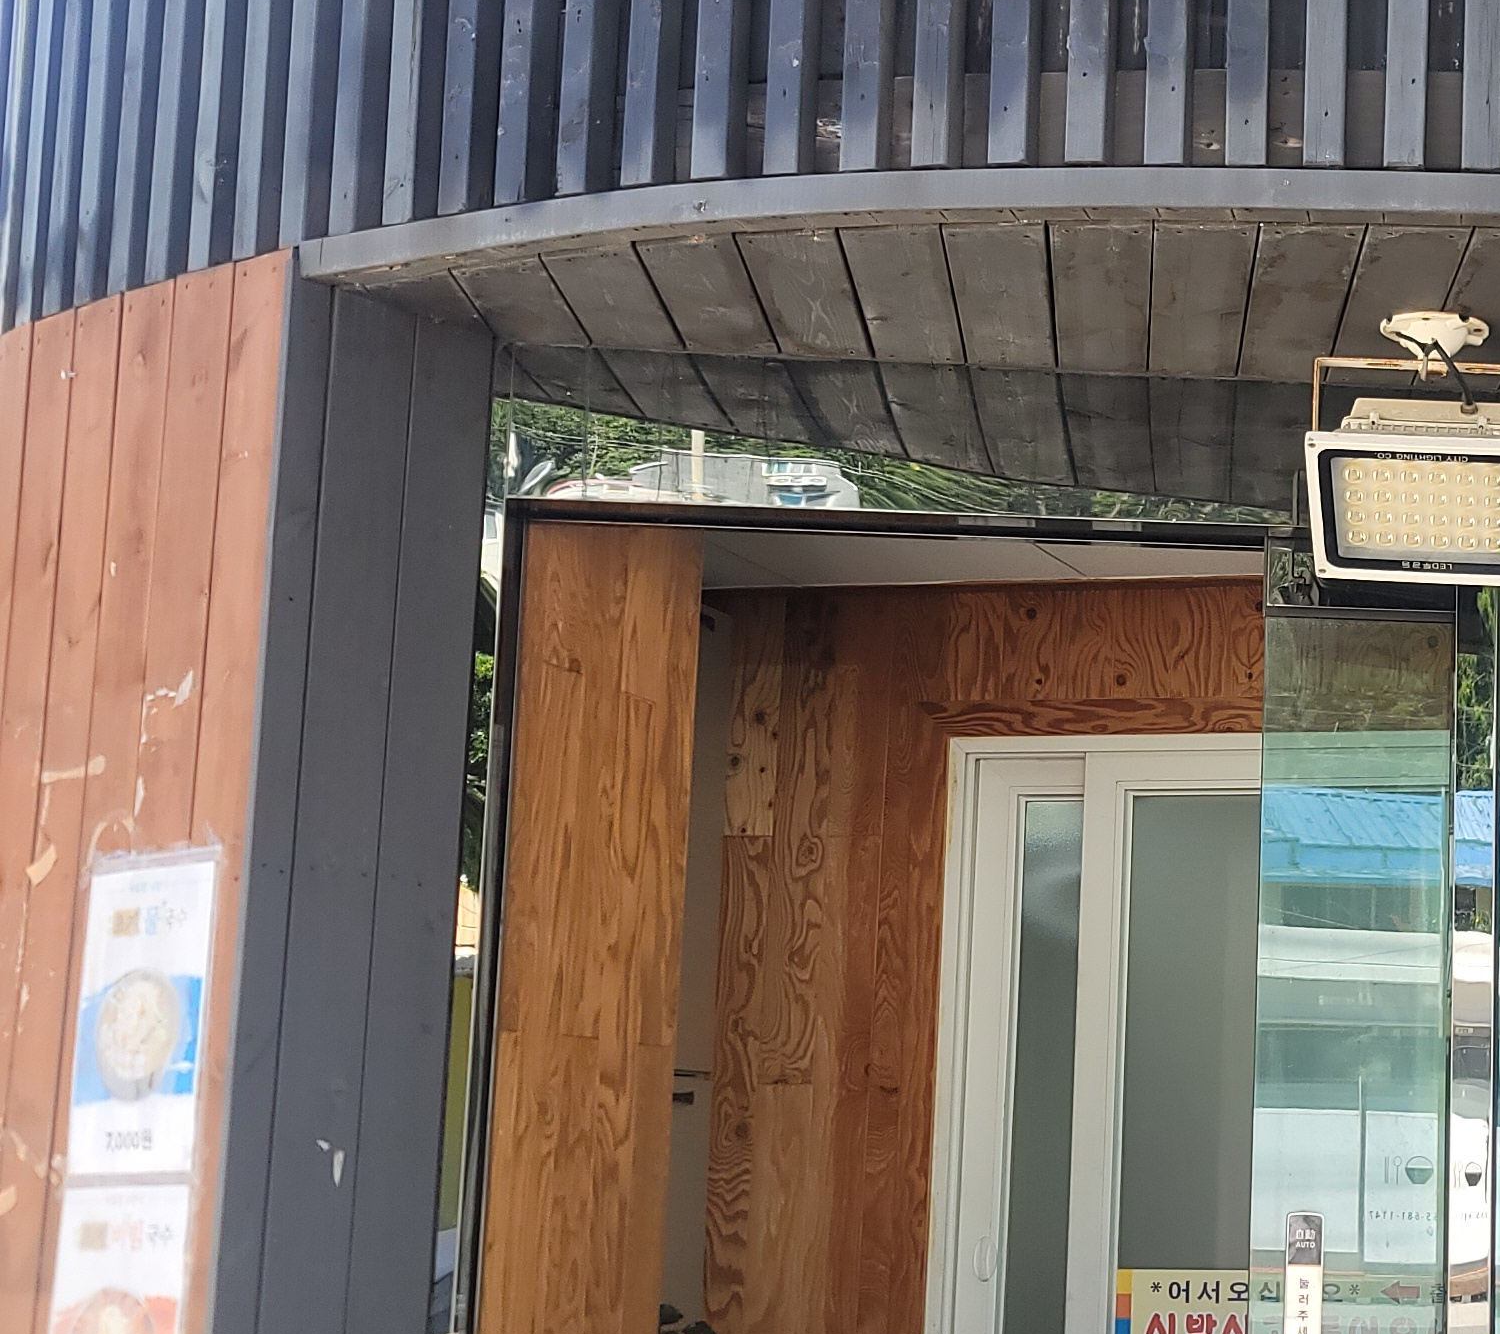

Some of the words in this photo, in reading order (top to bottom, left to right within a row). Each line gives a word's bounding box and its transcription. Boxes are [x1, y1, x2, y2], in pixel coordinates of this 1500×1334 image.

[1374, 452, 1392, 460] CO.
[1396, 453, 1442, 462] LIGHTING
[1446, 455, 1469, 463] CITY
[1295, 1241, 1316, 1249] AUTO
